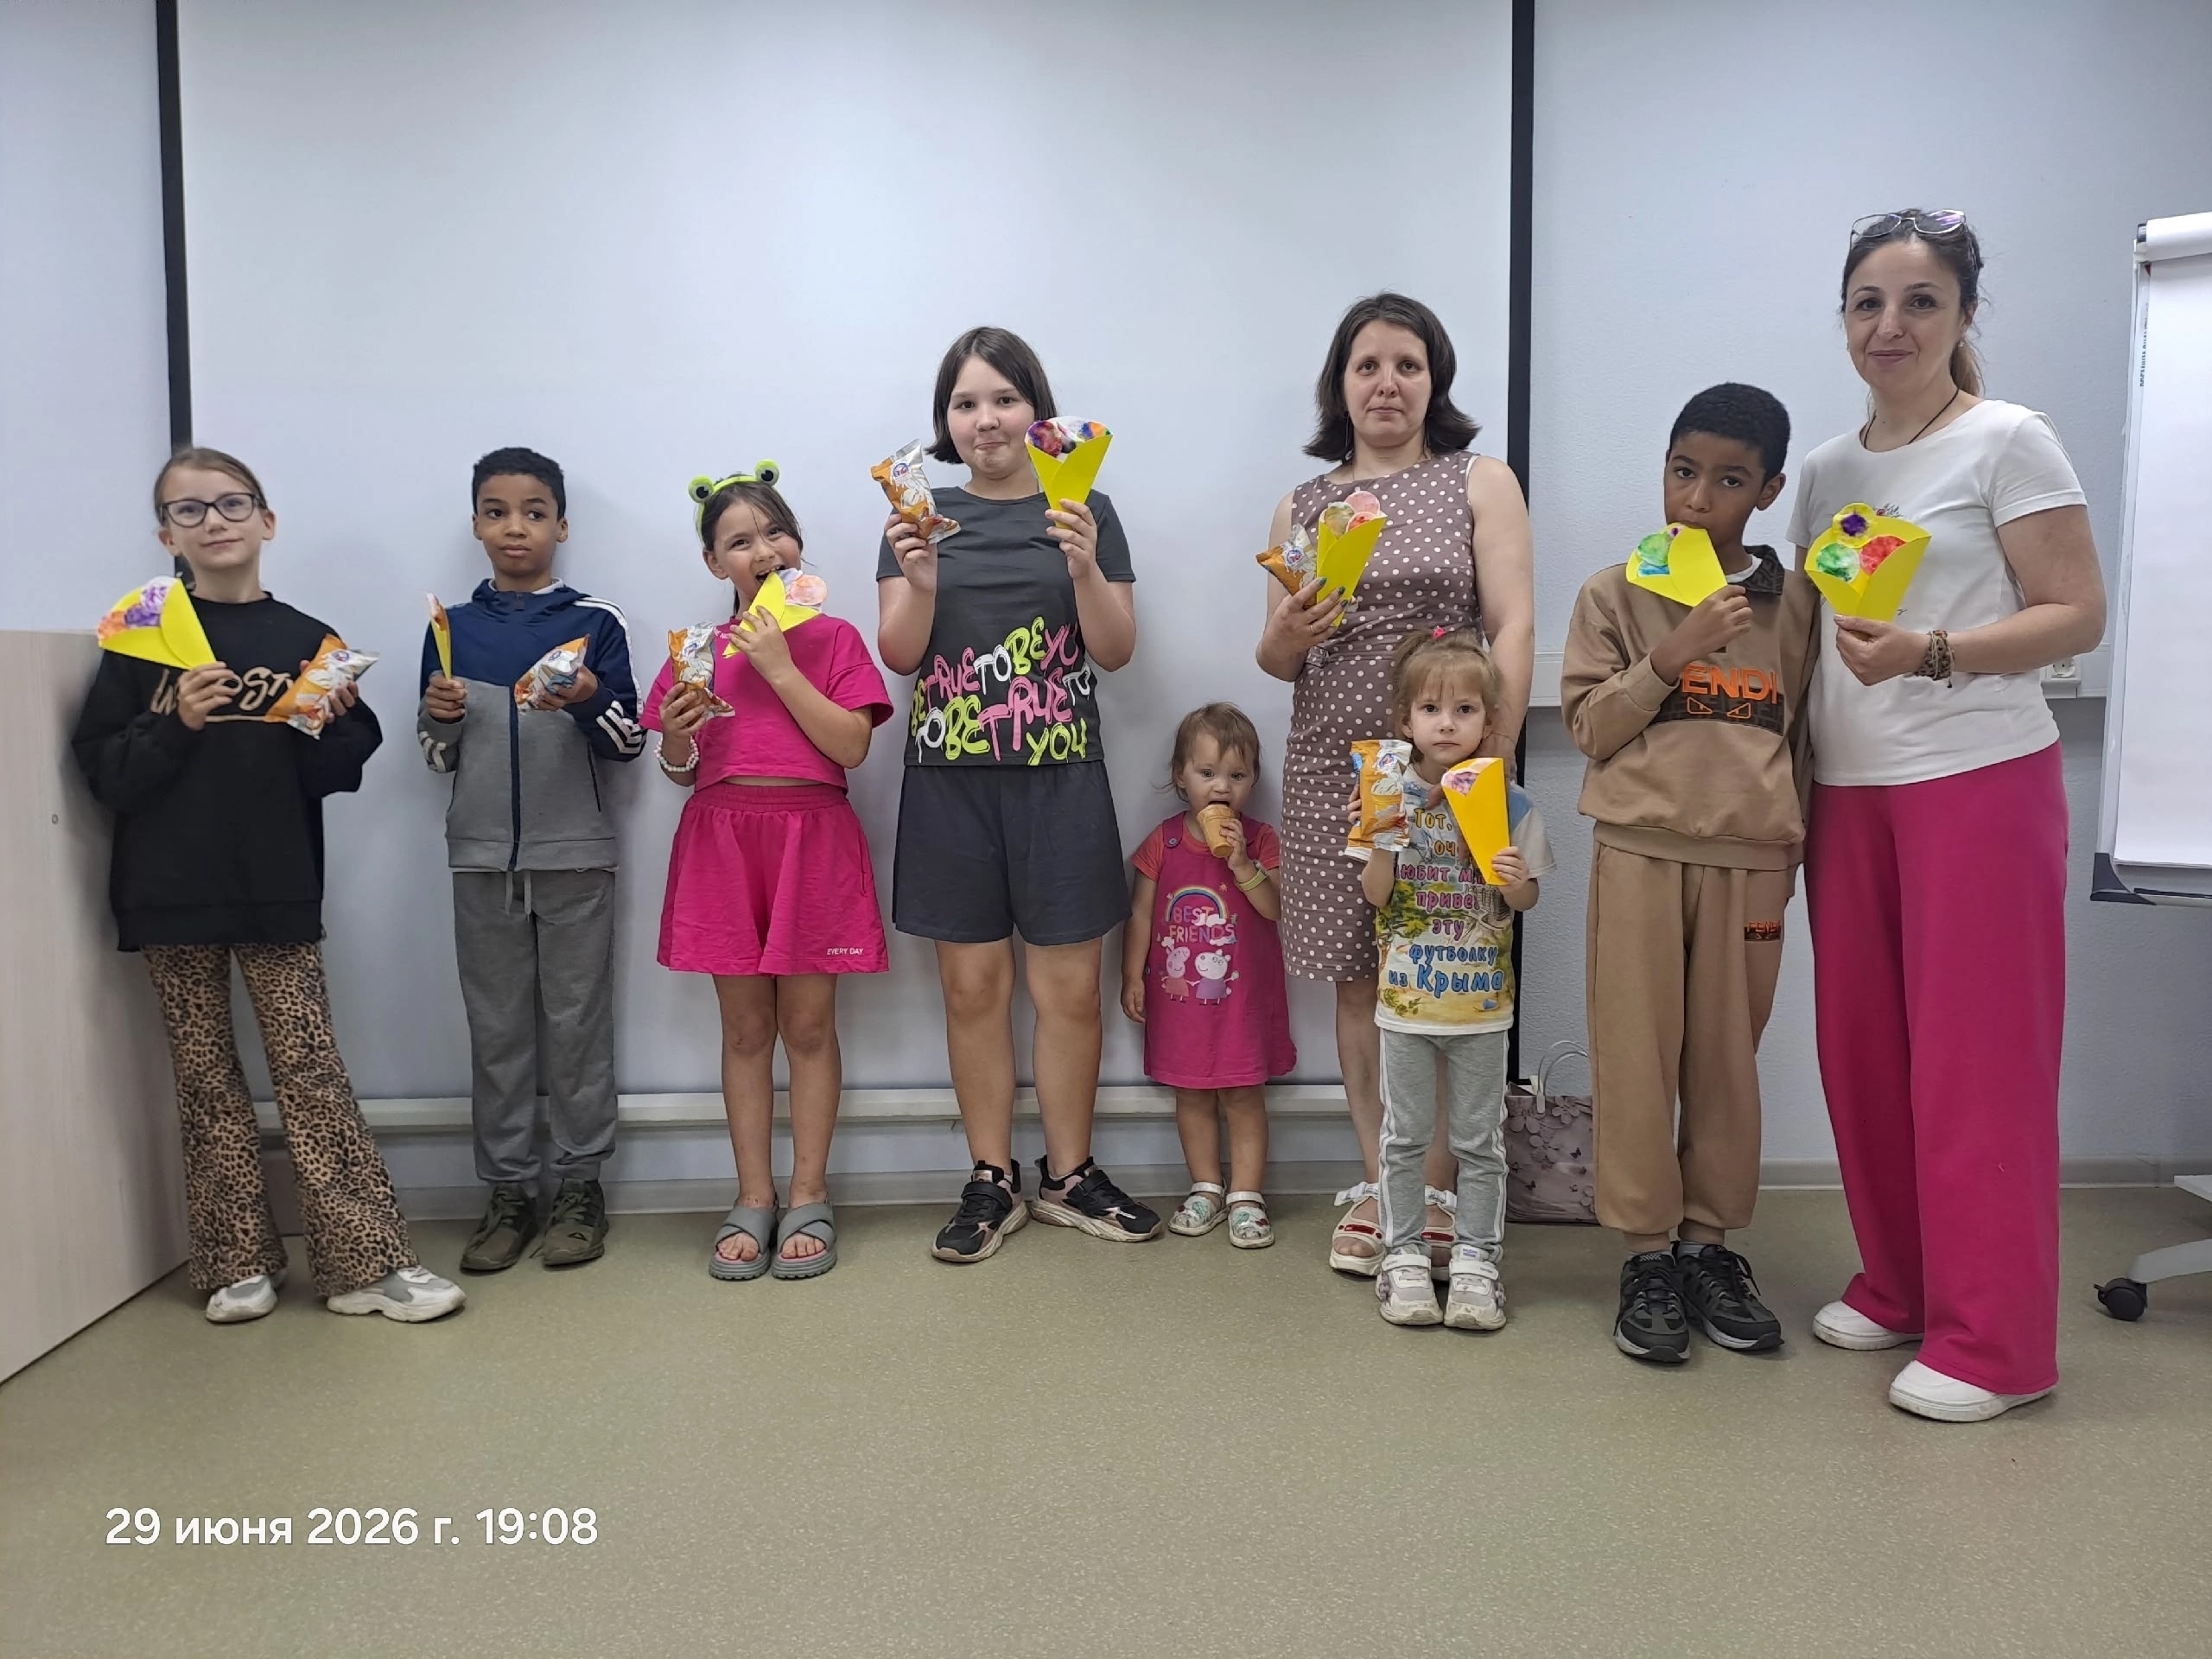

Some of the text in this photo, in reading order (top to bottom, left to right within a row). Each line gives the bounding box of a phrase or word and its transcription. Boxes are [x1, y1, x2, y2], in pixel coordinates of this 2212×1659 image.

[925, 646, 981, 711] TRUE
[973, 644, 1013, 696] TO
[1003, 616, 1047, 675] BE
[1681, 663, 1778, 705] ENDI
[914, 706, 947, 764] TO
[944, 694, 991, 760] BE
[976, 667, 1073, 762] TRUE
[1026, 717, 1087, 766] YOU
[1168, 923, 1236, 944] FRIENDS
[1172, 905, 1215, 925] BEST
[826, 947, 864, 956] EVERY DAY
